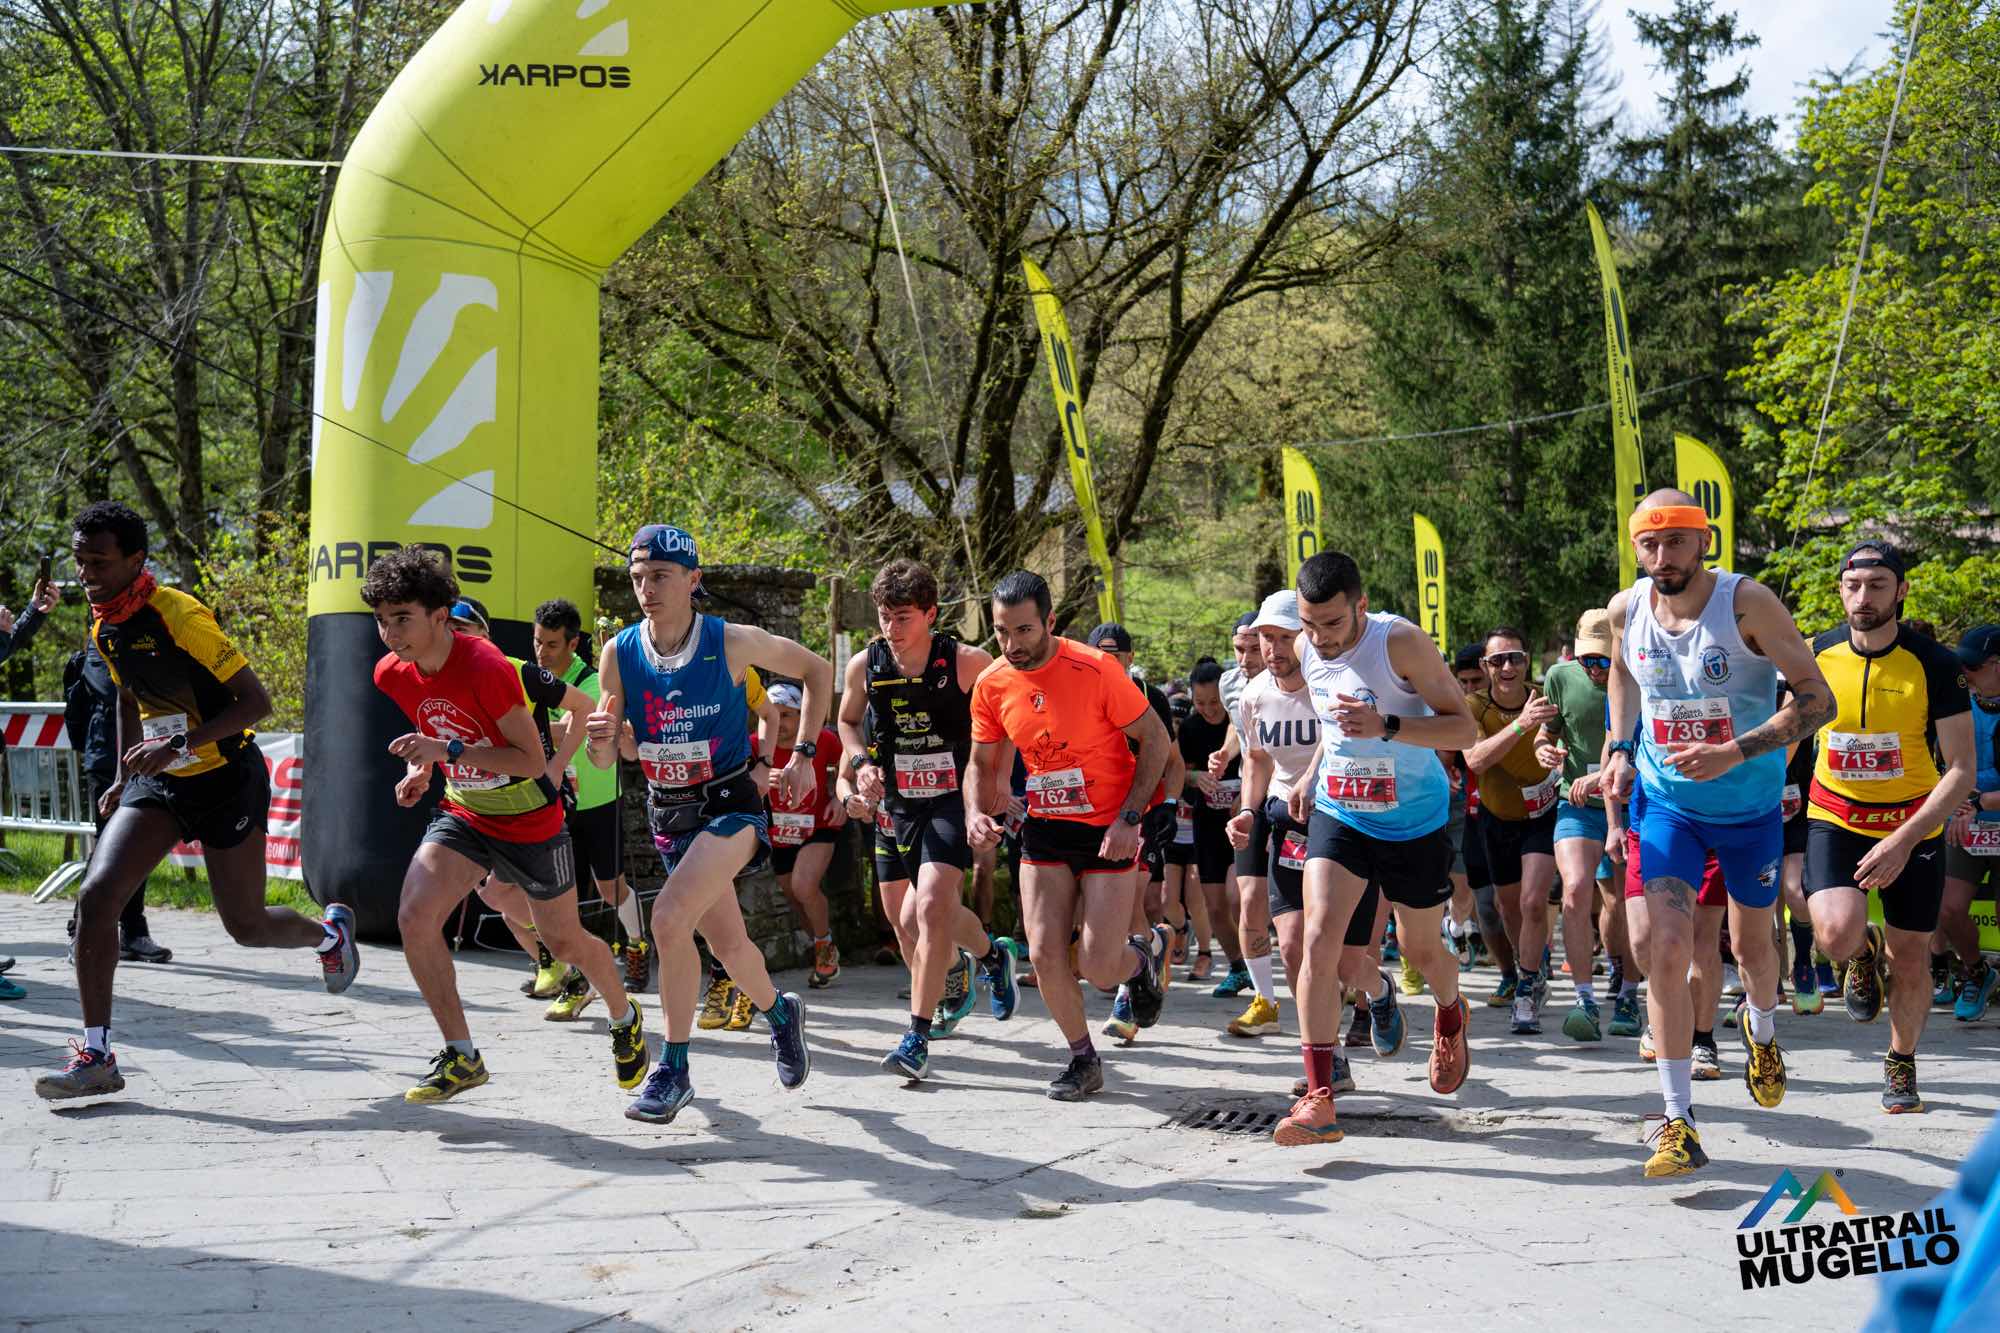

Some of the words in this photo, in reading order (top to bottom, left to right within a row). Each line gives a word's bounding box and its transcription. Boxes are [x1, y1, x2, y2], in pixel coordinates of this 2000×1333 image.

[478, 64, 631, 88] KARPOS
[659, 703, 721, 721] valtellina
[661, 719, 694, 734] wine
[1259, 718, 1322, 747] MIU
[1663, 721, 1707, 741] 736
[662, 732, 689, 745] trail
[1838, 751, 1878, 768] 715
[444, 763, 481, 779] 742
[651, 763, 688, 781] 738
[905, 771, 937, 786] 719
[1035, 788, 1069, 805] 762
[1336, 778, 1372, 798] 717
[1849, 810, 1906, 823] LEKI
[777, 825, 801, 837] 722
[1971, 831, 2000, 845] 735
